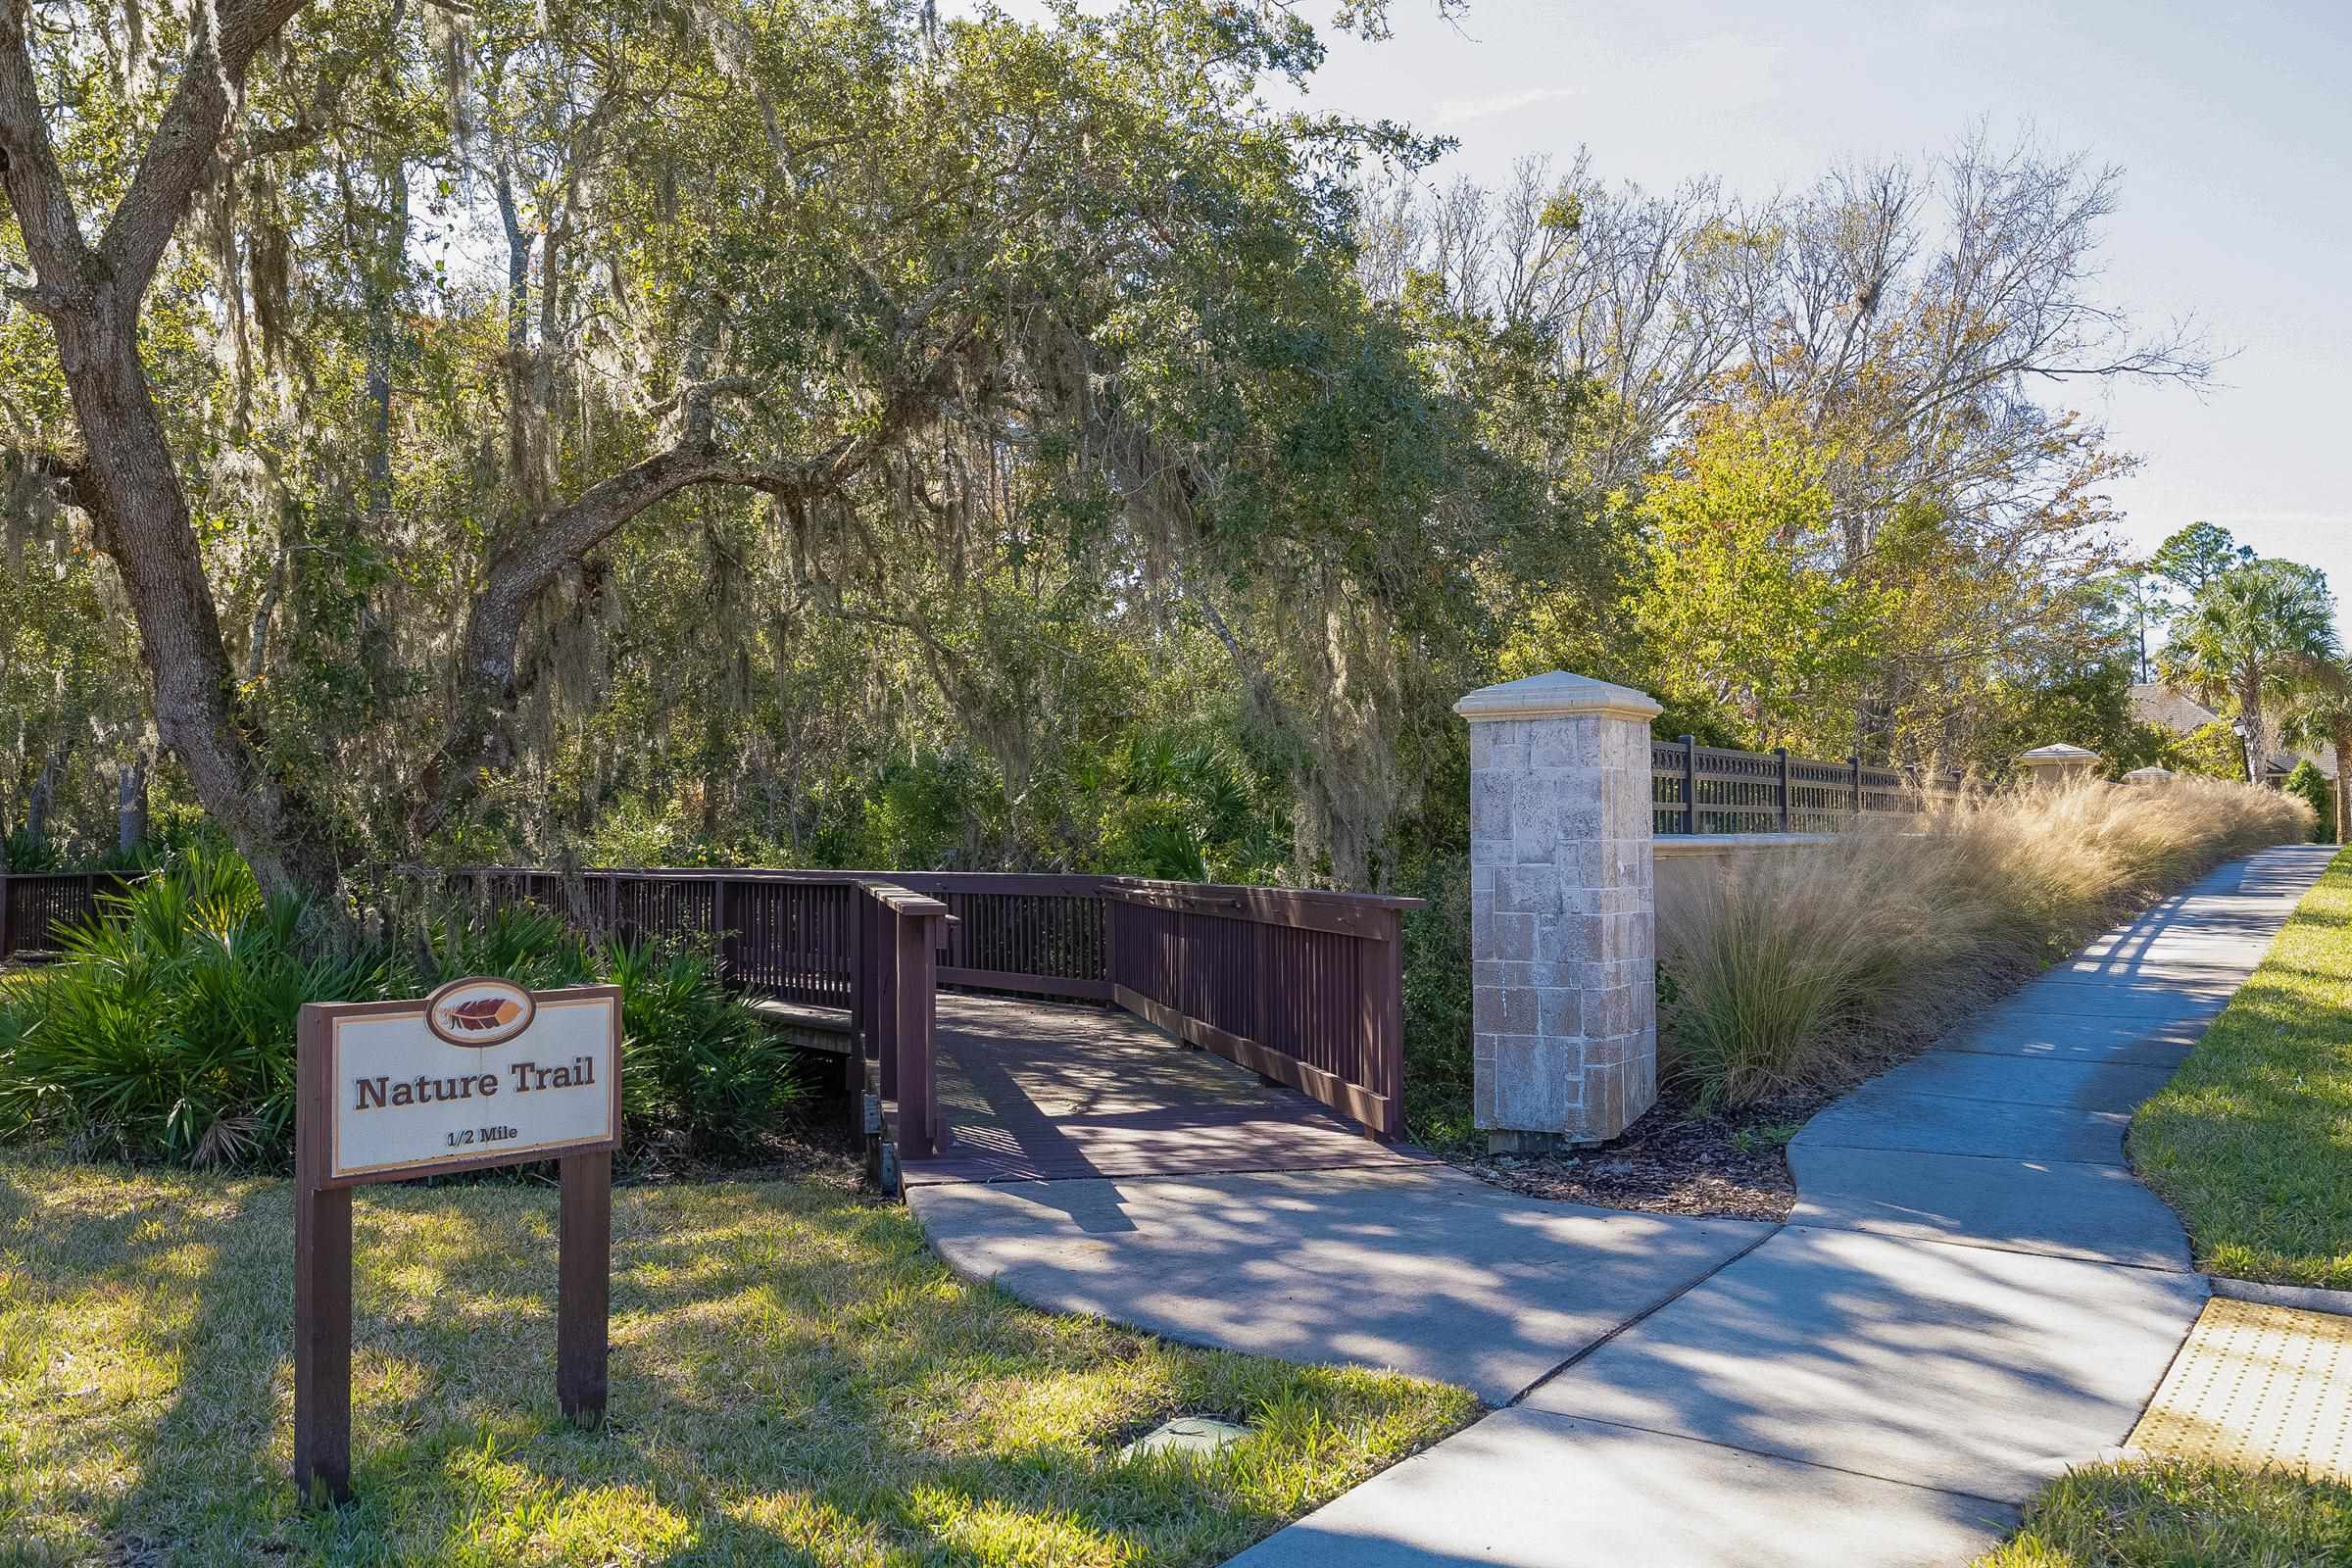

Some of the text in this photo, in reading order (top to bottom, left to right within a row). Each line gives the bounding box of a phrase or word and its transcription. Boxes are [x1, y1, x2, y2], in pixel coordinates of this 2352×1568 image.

[354, 1056, 596, 1110] Nature Trail
[447, 1126, 518, 1147] 1/2 Mile
